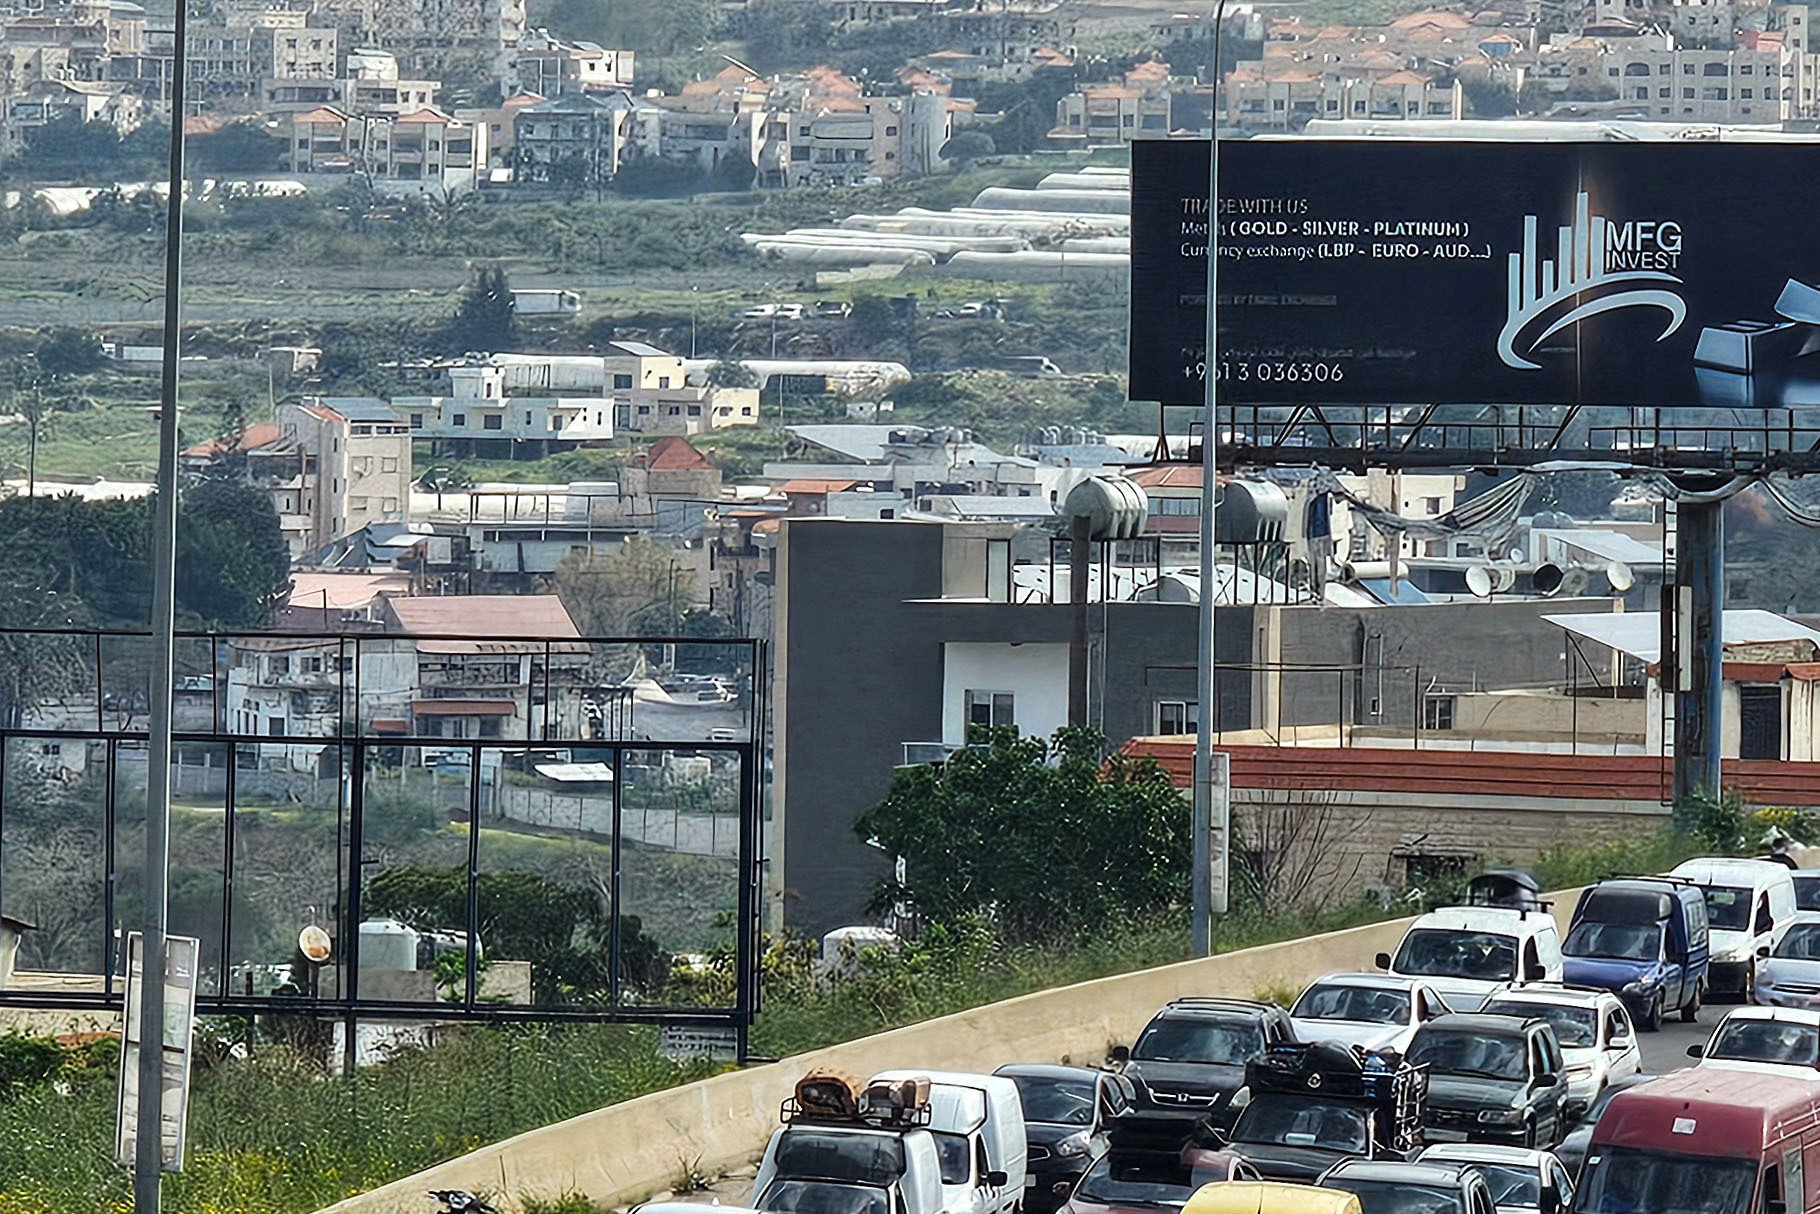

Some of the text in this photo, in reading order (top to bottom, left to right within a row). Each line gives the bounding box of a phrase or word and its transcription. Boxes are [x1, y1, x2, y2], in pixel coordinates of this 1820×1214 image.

[1239, 198, 1282, 214] WITH
[1287, 198, 1309, 214] US
[1302, 220, 1359, 236] SILVER
[1606, 221, 1682, 251] MFG
[1181, 242, 1243, 260] Curncy
[1246, 244, 1315, 261] exchange
[1318, 242, 1355, 259] (LBP
[1372, 243, 1419, 258] EURO
[1605, 251, 1680, 269] INVEST
[1238, 362, 1250, 381] 3
[1257, 362, 1344, 382] 036306
